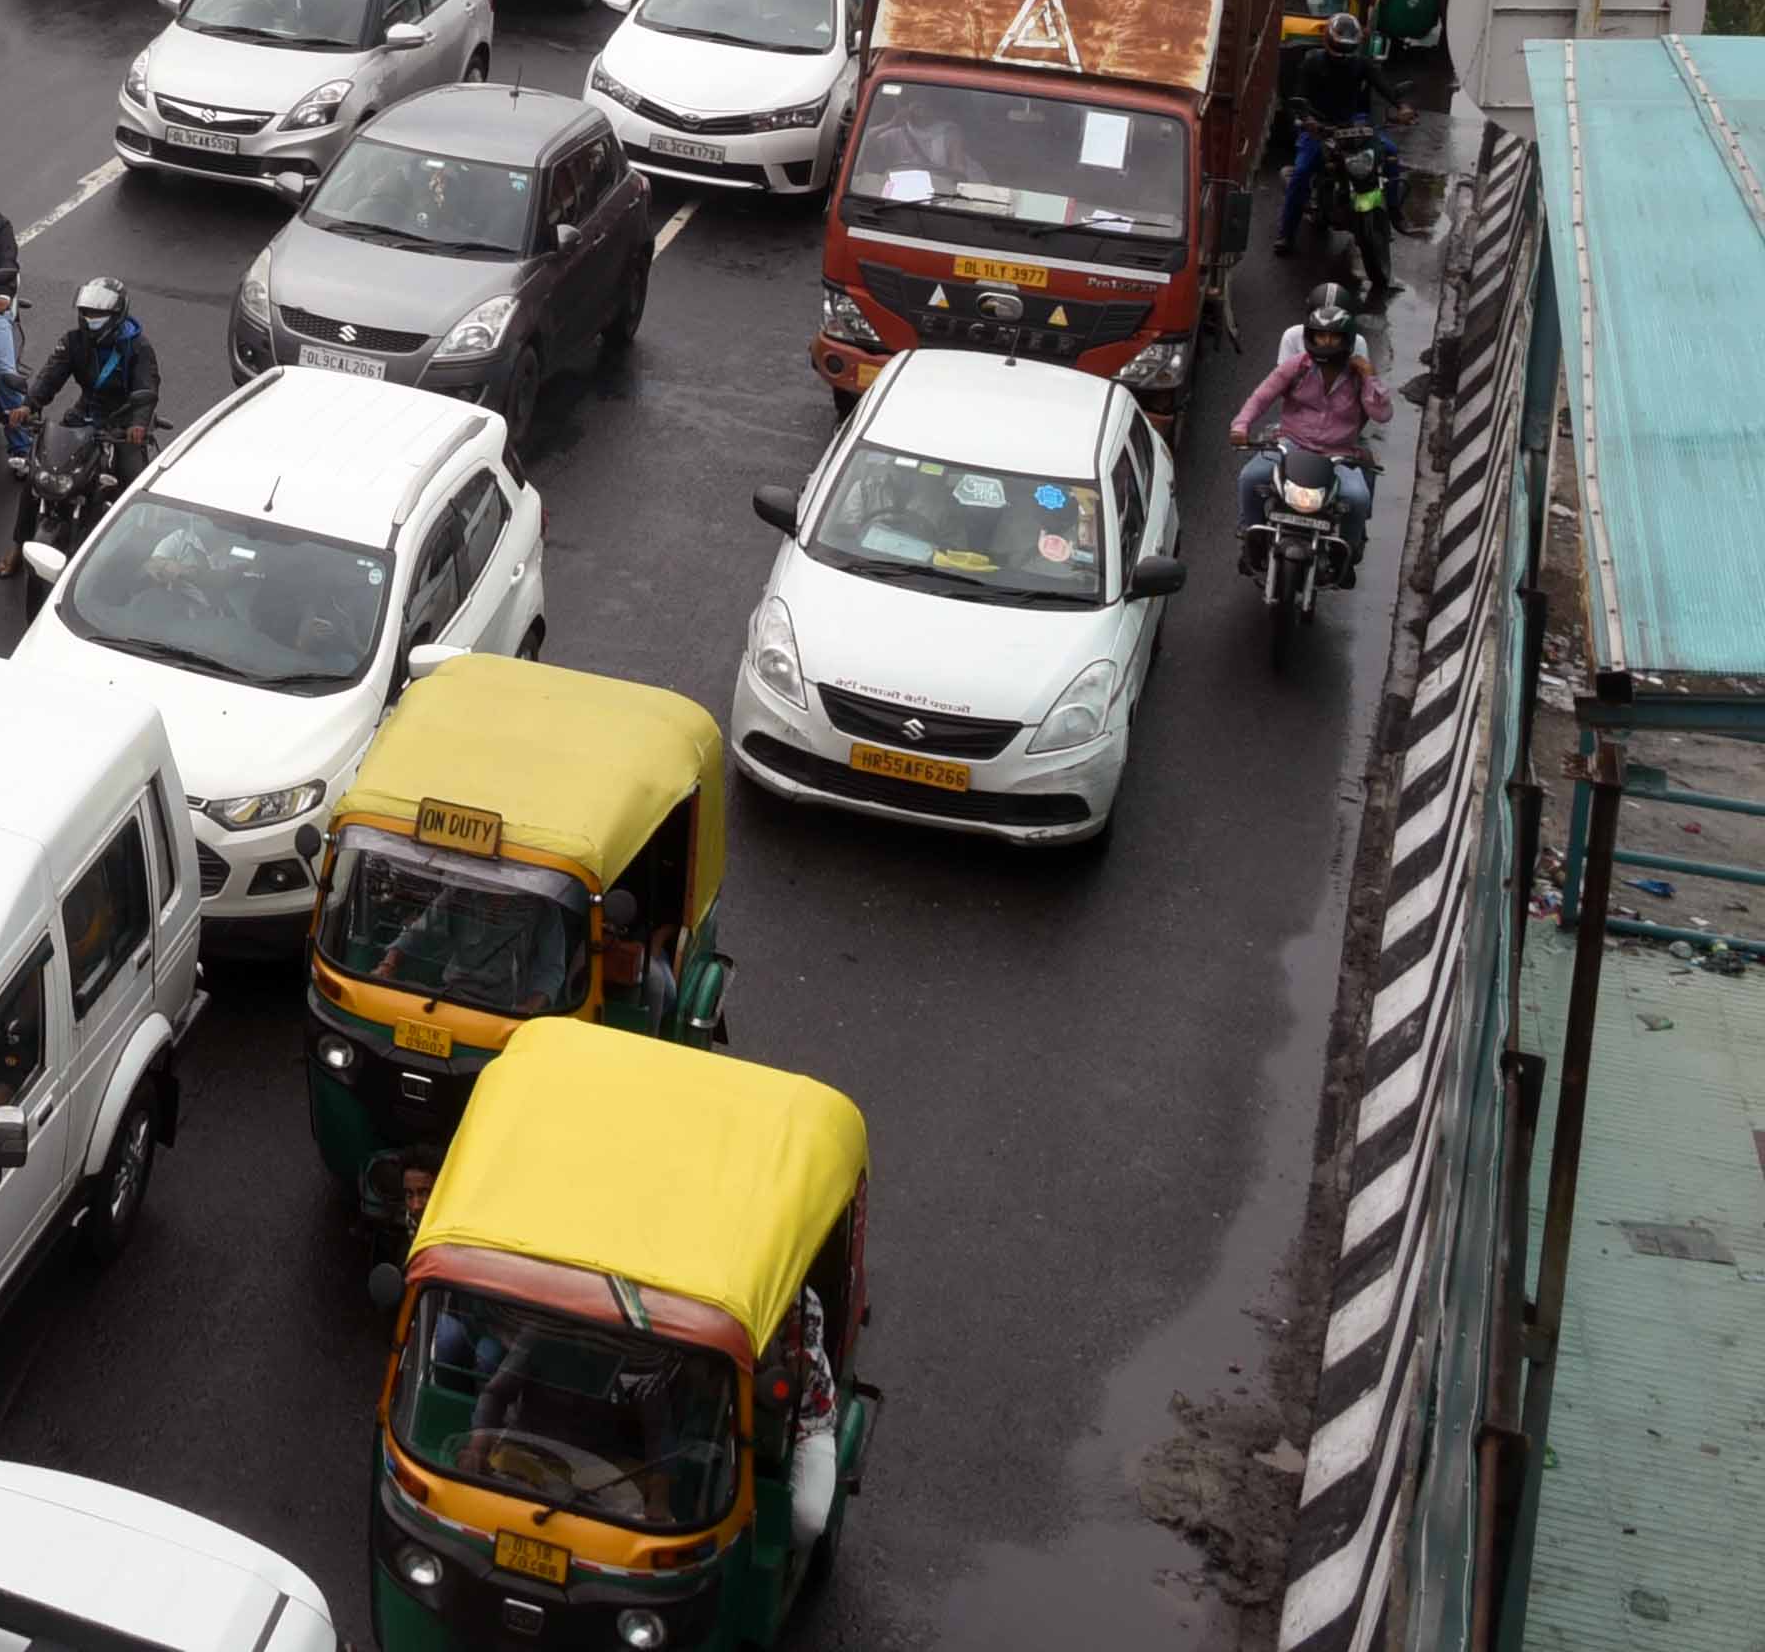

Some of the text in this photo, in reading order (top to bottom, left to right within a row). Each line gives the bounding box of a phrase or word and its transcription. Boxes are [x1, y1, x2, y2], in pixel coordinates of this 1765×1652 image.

[963, 261, 978, 276] DL
[1012, 266, 1046, 285] 3977
[306, 350, 383, 380] DL9CAL2061
[860, 752, 967, 788] HR55AF6266
[422, 806, 497, 844] ON DUTY
